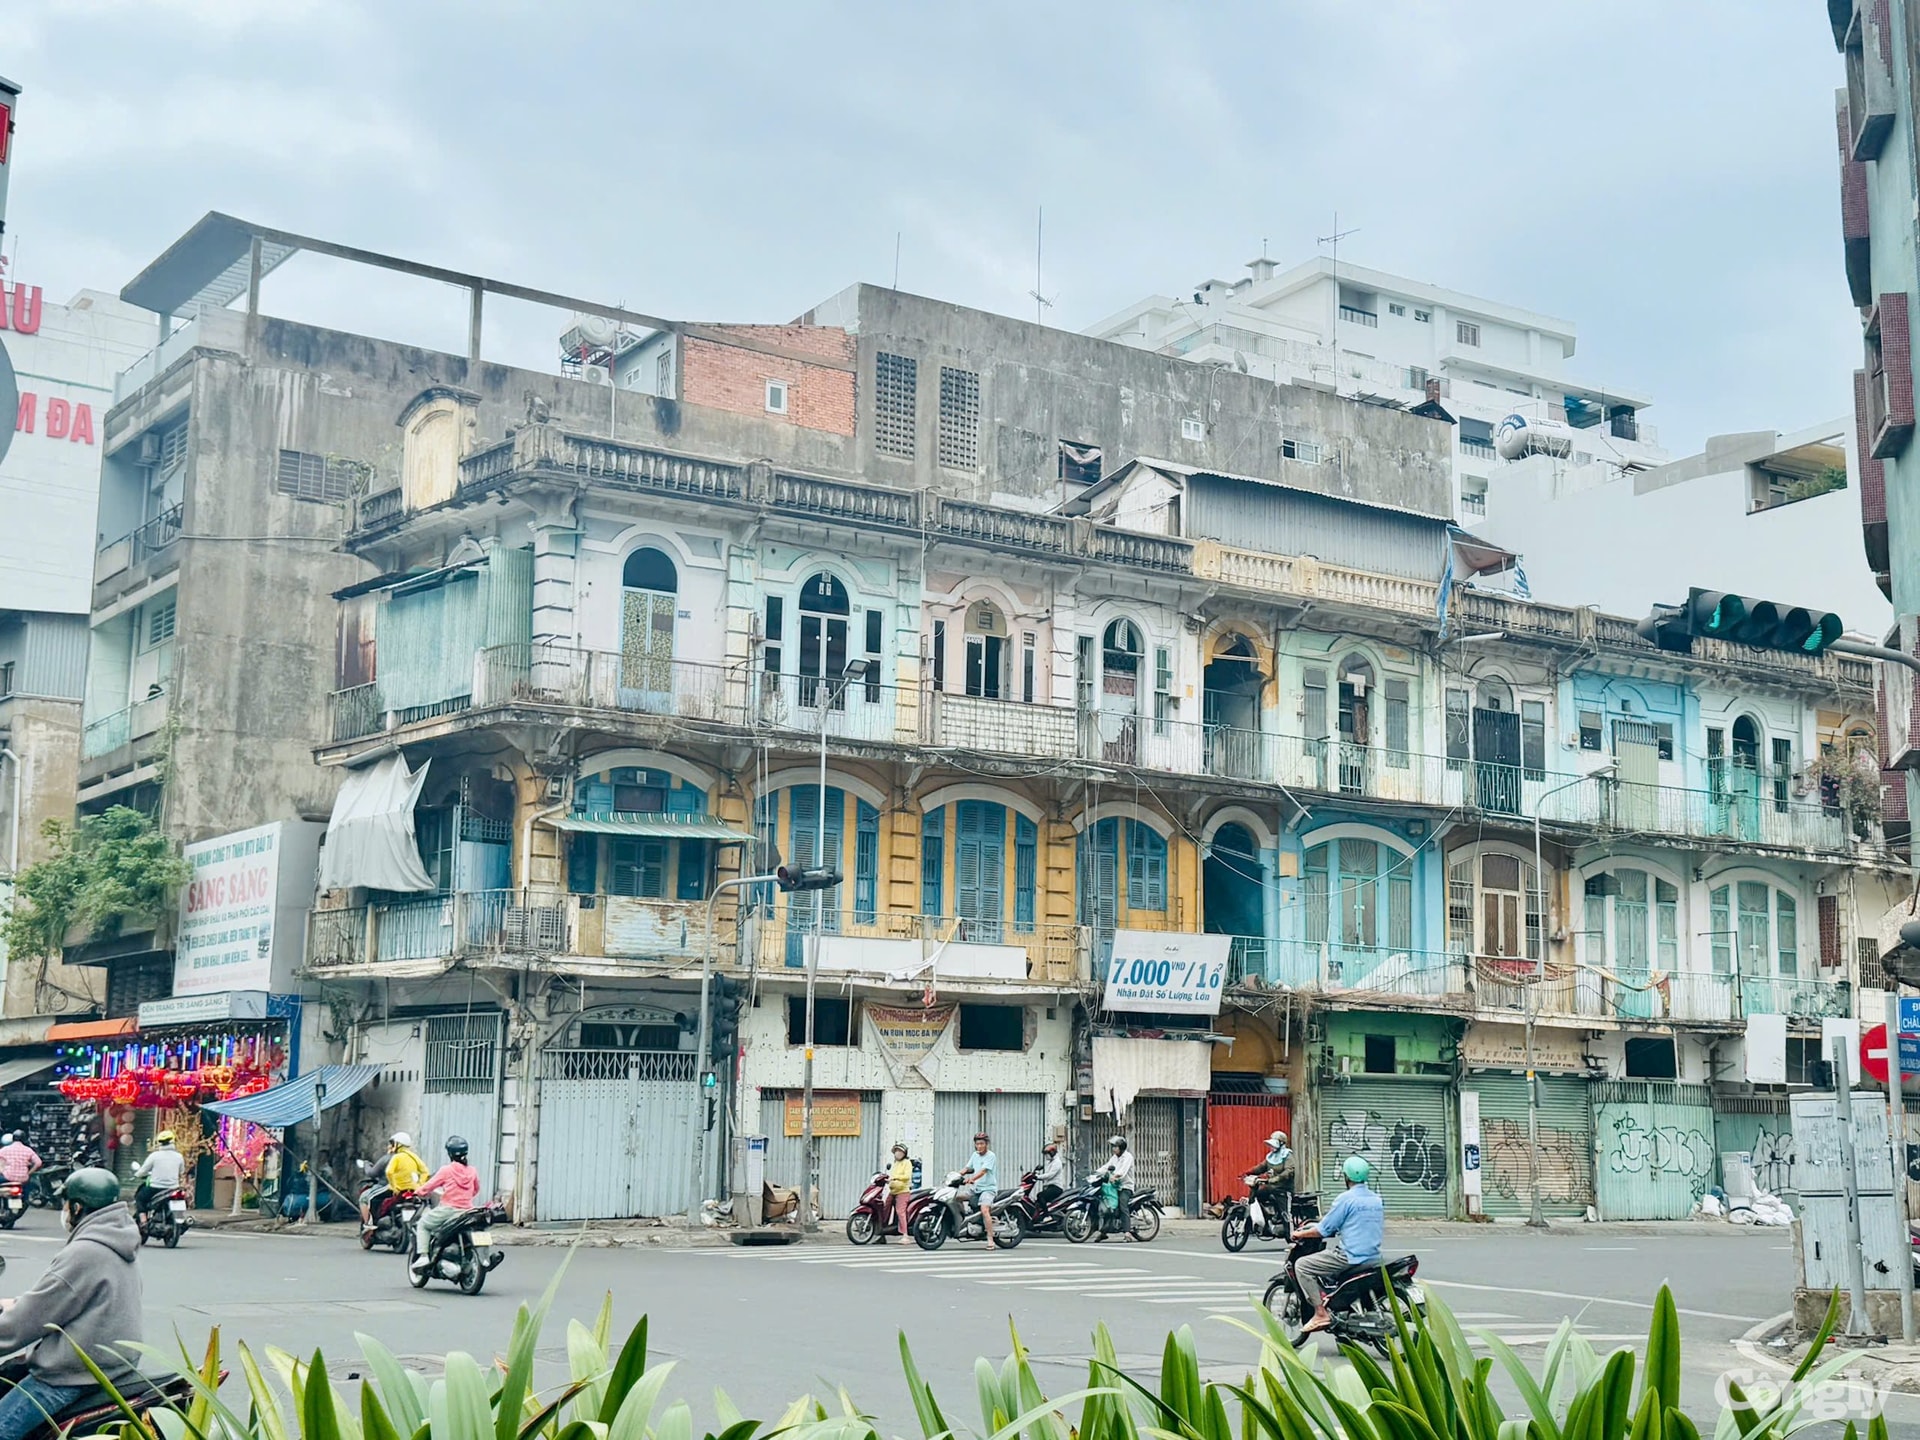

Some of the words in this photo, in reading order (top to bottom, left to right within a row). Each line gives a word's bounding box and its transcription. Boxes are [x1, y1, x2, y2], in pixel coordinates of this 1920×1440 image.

[46, 397, 95, 446] ĐA
[188, 877, 225, 913] SANG
[229, 862, 268, 904] SÁNG
[1116, 988, 1137, 999] Nhận
[1139, 989, 1153, 1001] Đặt
[1155, 988, 1168, 999] Số
[1168, 991, 1192, 1002] Lượng
[1194, 991, 1210, 1001] Lớn
